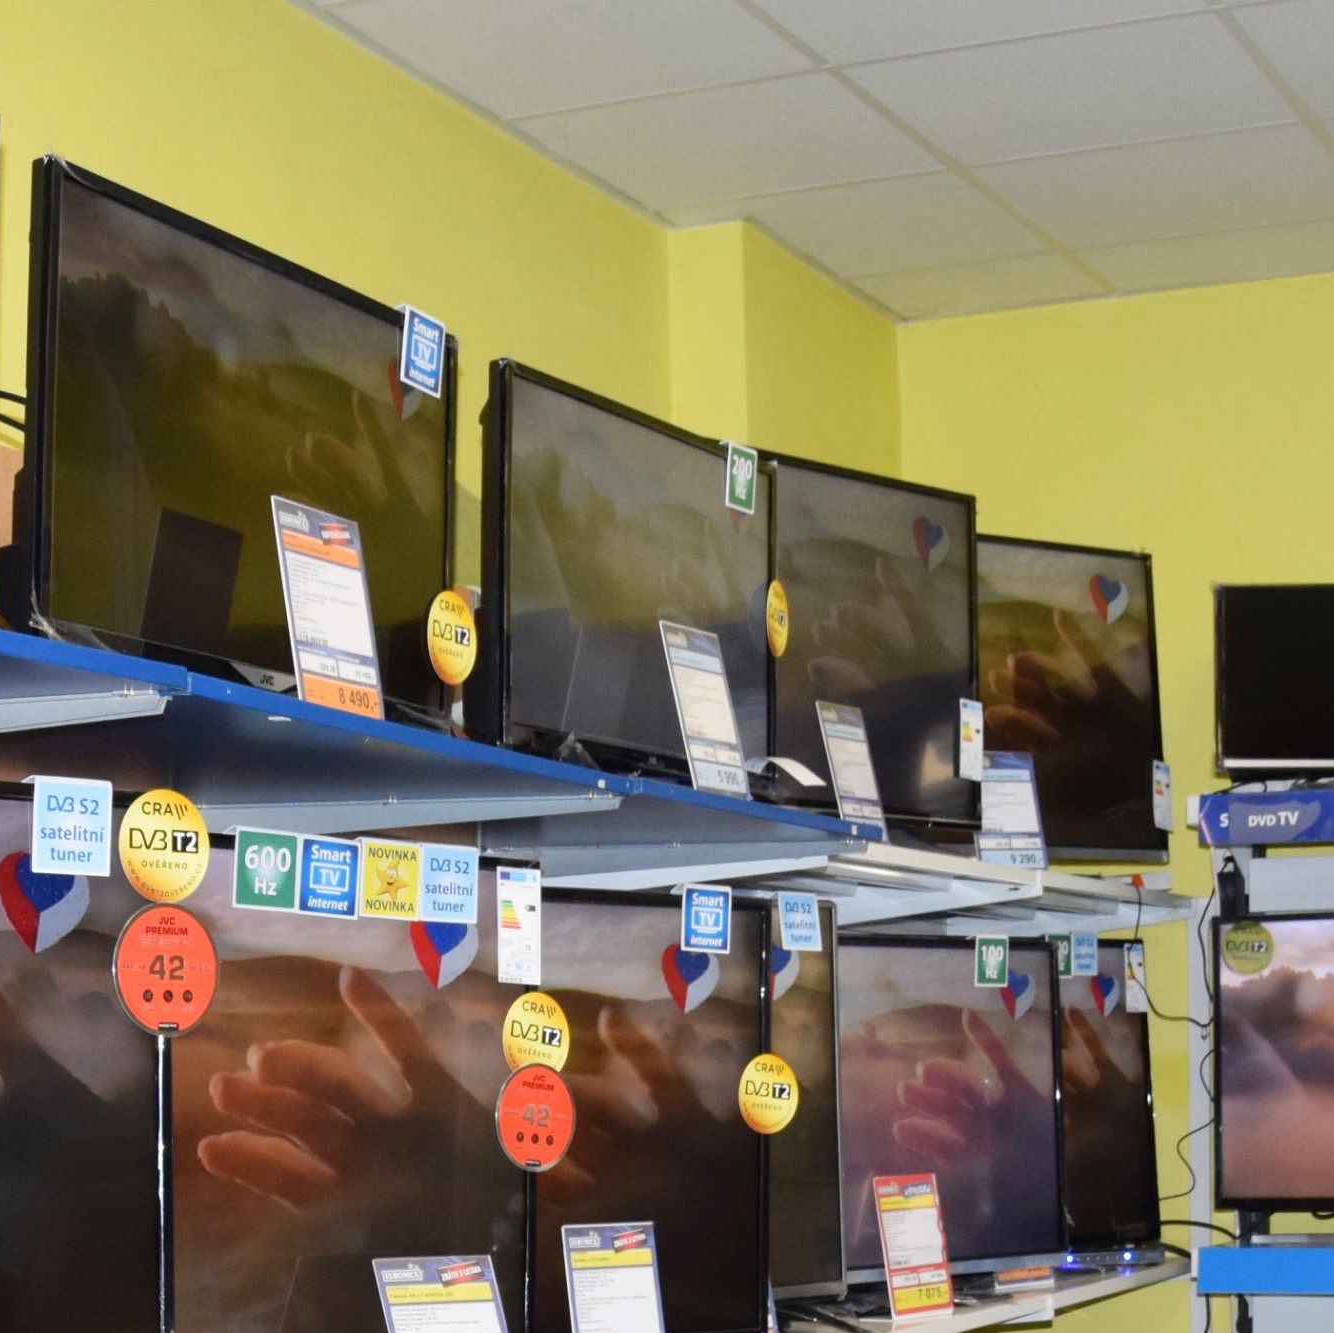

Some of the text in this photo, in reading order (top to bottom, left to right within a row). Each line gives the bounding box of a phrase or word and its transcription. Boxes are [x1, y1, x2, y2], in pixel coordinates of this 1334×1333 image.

[413, 317, 439, 343] Smart
[416, 342, 433, 360] TV
[409, 367, 435, 388] internet
[732, 456, 752, 478] 200
[79, 799, 99, 816] S2
[1247, 811, 1299, 829] DVD TV
[40, 825, 104, 843] satelitní
[50, 846, 92, 863] tuner
[244, 845, 291, 873] 600
[311, 845, 351, 864] Smart
[368, 847, 416, 862] NOVINKA
[454, 860, 469, 874] S2
[254, 876, 276, 896] Hz
[425, 882, 473, 896] satelitní
[308, 895, 348, 911] internet
[365, 899, 414, 913] NOVINKA
[433, 900, 464, 912] tuner
[692, 893, 724, 907] Smart
[158, 917, 175, 925] JVC
[699, 912, 715, 926] TV
[145, 926, 189, 936] PREMIUM
[791, 933, 812, 943] tuner
[690, 937, 723, 947] internet
[981, 946, 1003, 962] 100
[149, 954, 185, 981] 42
[543, 1028, 561, 1047] T2
[522, 1082, 555, 1093] PREMIUM
[774, 1084, 790, 1099] T2
[522, 1103, 550, 1128] 42
